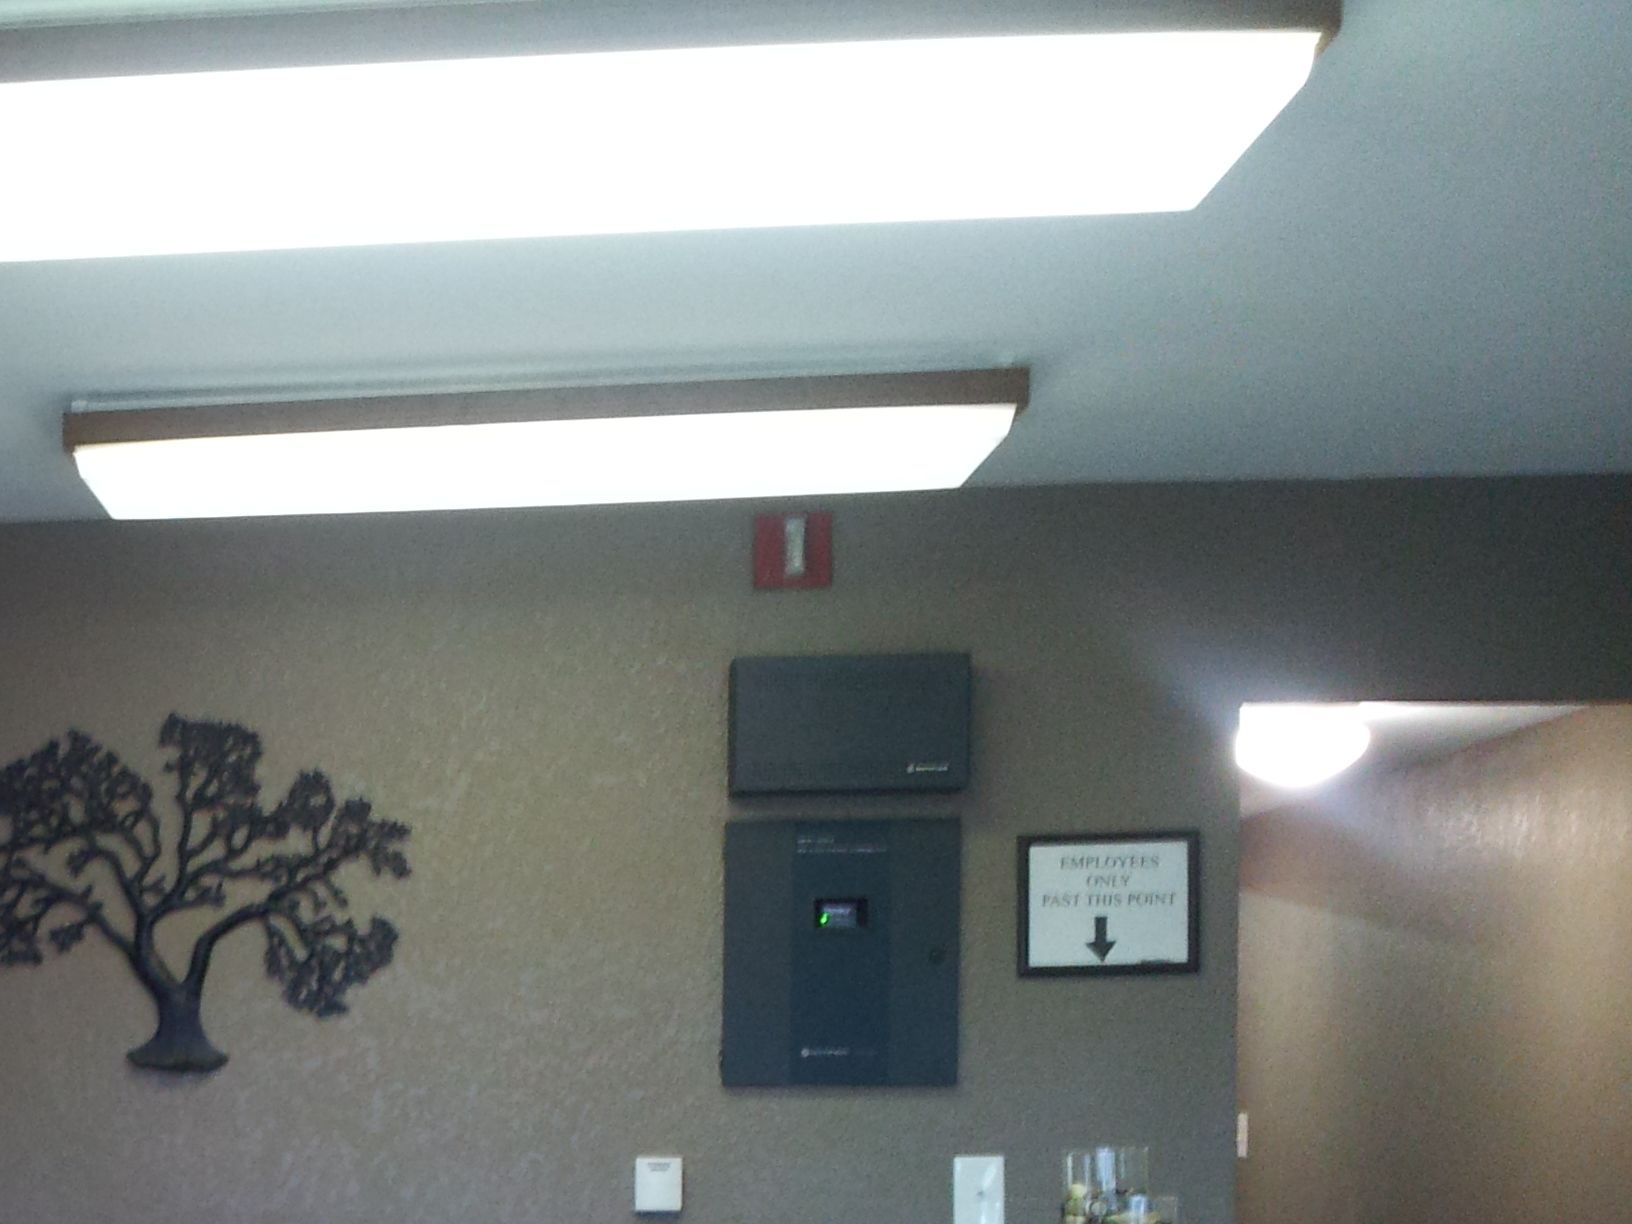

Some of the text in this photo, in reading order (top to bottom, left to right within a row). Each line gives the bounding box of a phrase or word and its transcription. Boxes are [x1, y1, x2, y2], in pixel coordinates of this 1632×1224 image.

[1059, 856, 1160, 870] EMPLOYEES
[1086, 874, 1130, 888] ONLY
[1041, 892, 1176, 908] PAST THIS POINT
